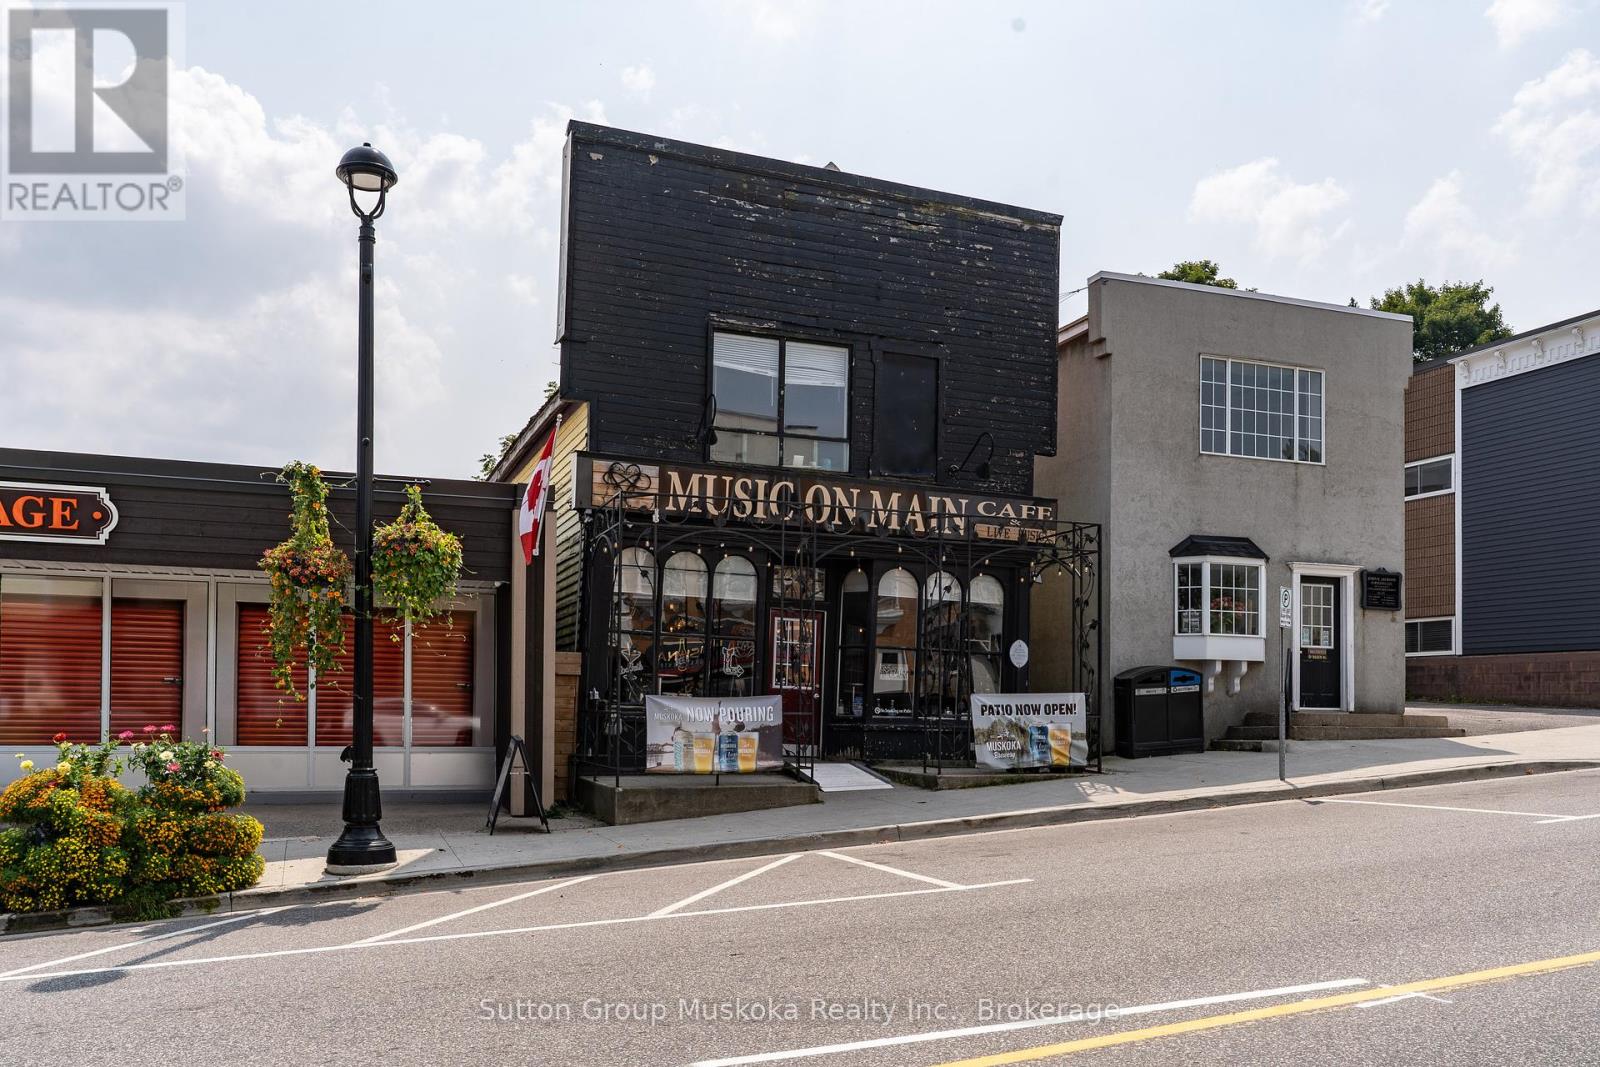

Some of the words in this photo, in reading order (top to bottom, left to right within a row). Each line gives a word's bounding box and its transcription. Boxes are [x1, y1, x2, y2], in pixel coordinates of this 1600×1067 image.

[665, 471, 794, 520] MUSIC
[805, 484, 861, 525] ON
[866, 490, 968, 536] MAIN
[977, 501, 1053, 520] CAFE
[687, 706, 715, 722] NOW
[719, 705, 774, 722] POURING
[980, 703, 1013, 716] PATIO
[1015, 703, 1041, 716] NOW
[1044, 703, 1077, 715] OPEN!
[986, 740, 1021, 751] MUSKOKA
